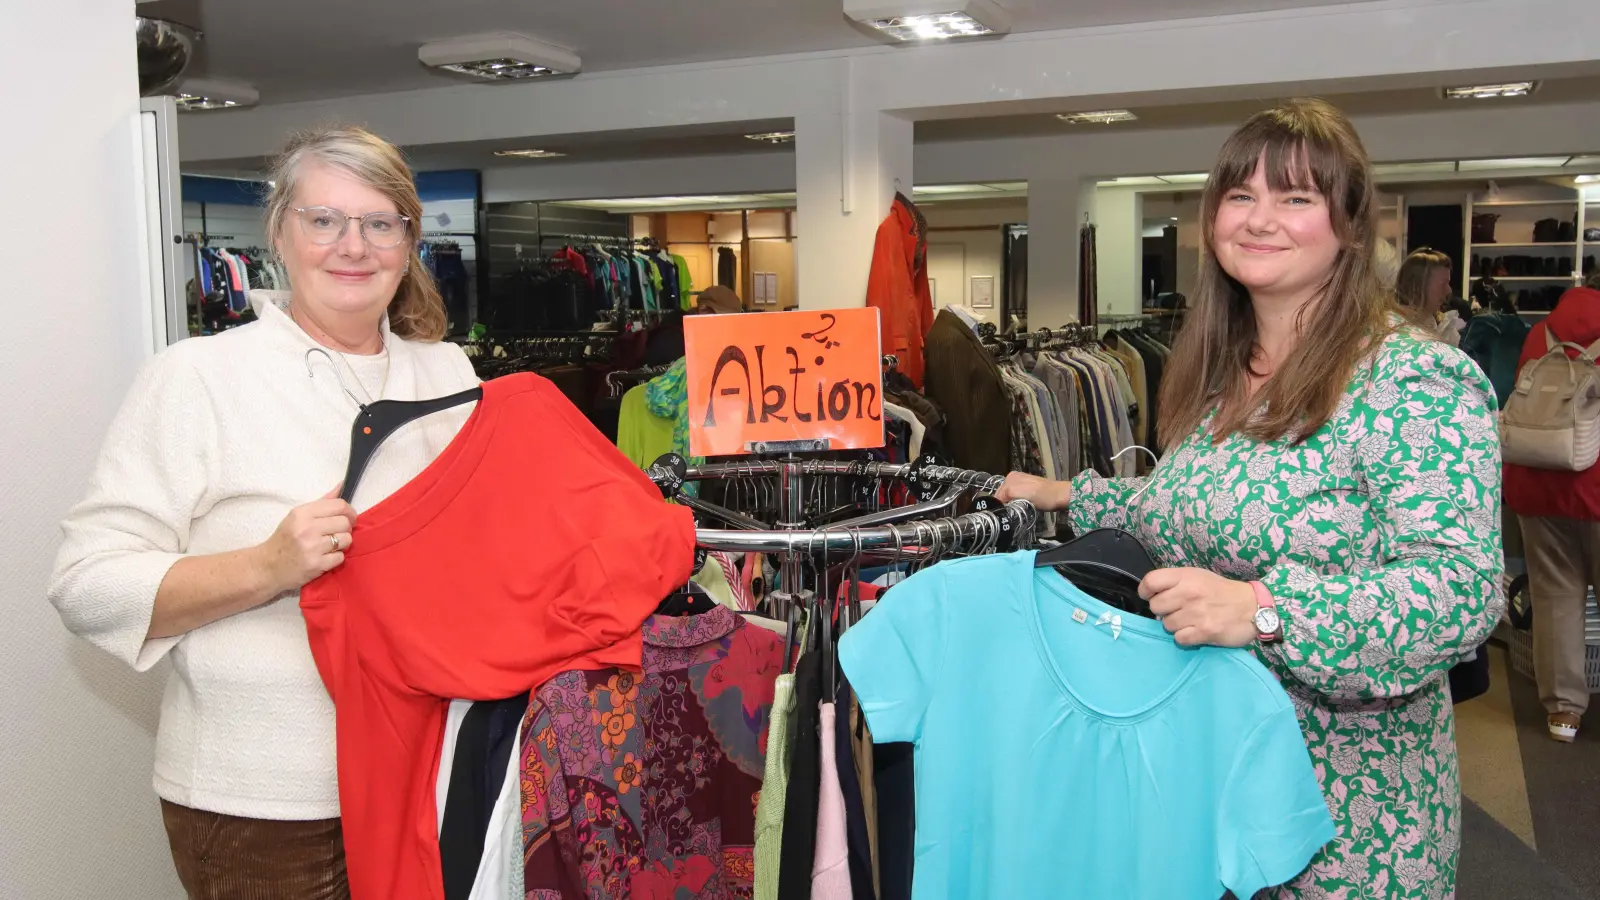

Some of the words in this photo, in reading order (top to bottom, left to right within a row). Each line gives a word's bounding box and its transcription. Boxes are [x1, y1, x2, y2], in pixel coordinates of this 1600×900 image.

[702, 345, 881, 428] Aktion
[670, 455, 680, 465] 38
[925, 455, 935, 464] 34
[910, 470, 917, 482] 34
[672, 477, 682, 488] 38
[921, 491, 931, 500] 34
[976, 500, 987, 510] 48
[1001, 516, 1010, 531] 48
